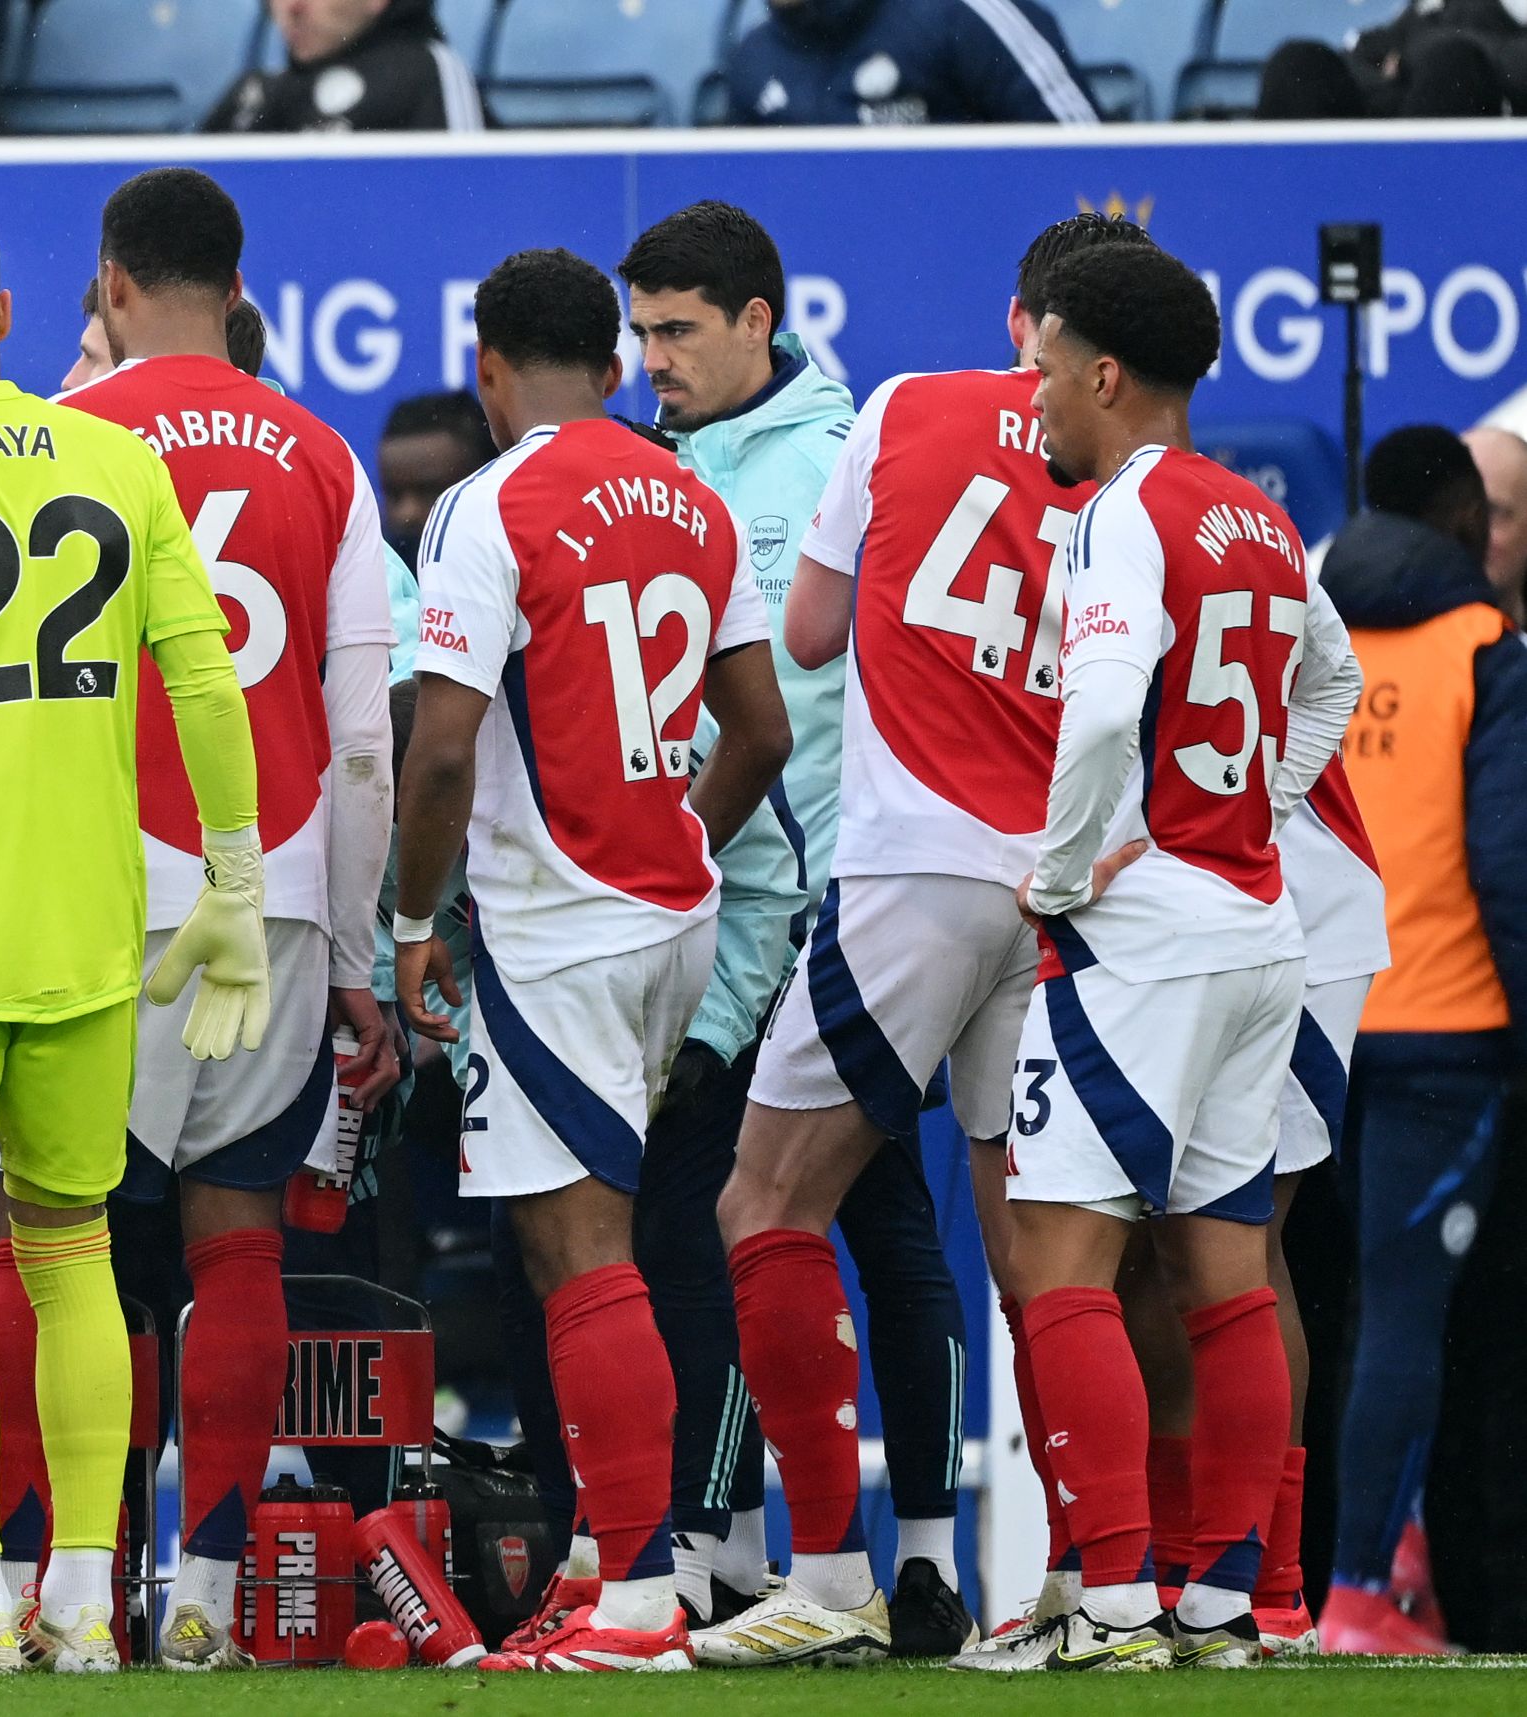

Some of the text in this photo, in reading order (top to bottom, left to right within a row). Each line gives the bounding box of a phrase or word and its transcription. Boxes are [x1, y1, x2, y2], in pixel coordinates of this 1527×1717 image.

[1369, 264, 1527, 380] PO
[556, 476, 709, 563] J. TIMBER
[1194, 503, 1301, 575] NWANERI
[188, 488, 288, 690] 6
[903, 474, 1078, 699] 41
[582, 572, 713, 780] 12
[1008, 1058, 1057, 1137] 3
[277, 1531, 317, 1638] PRIME
